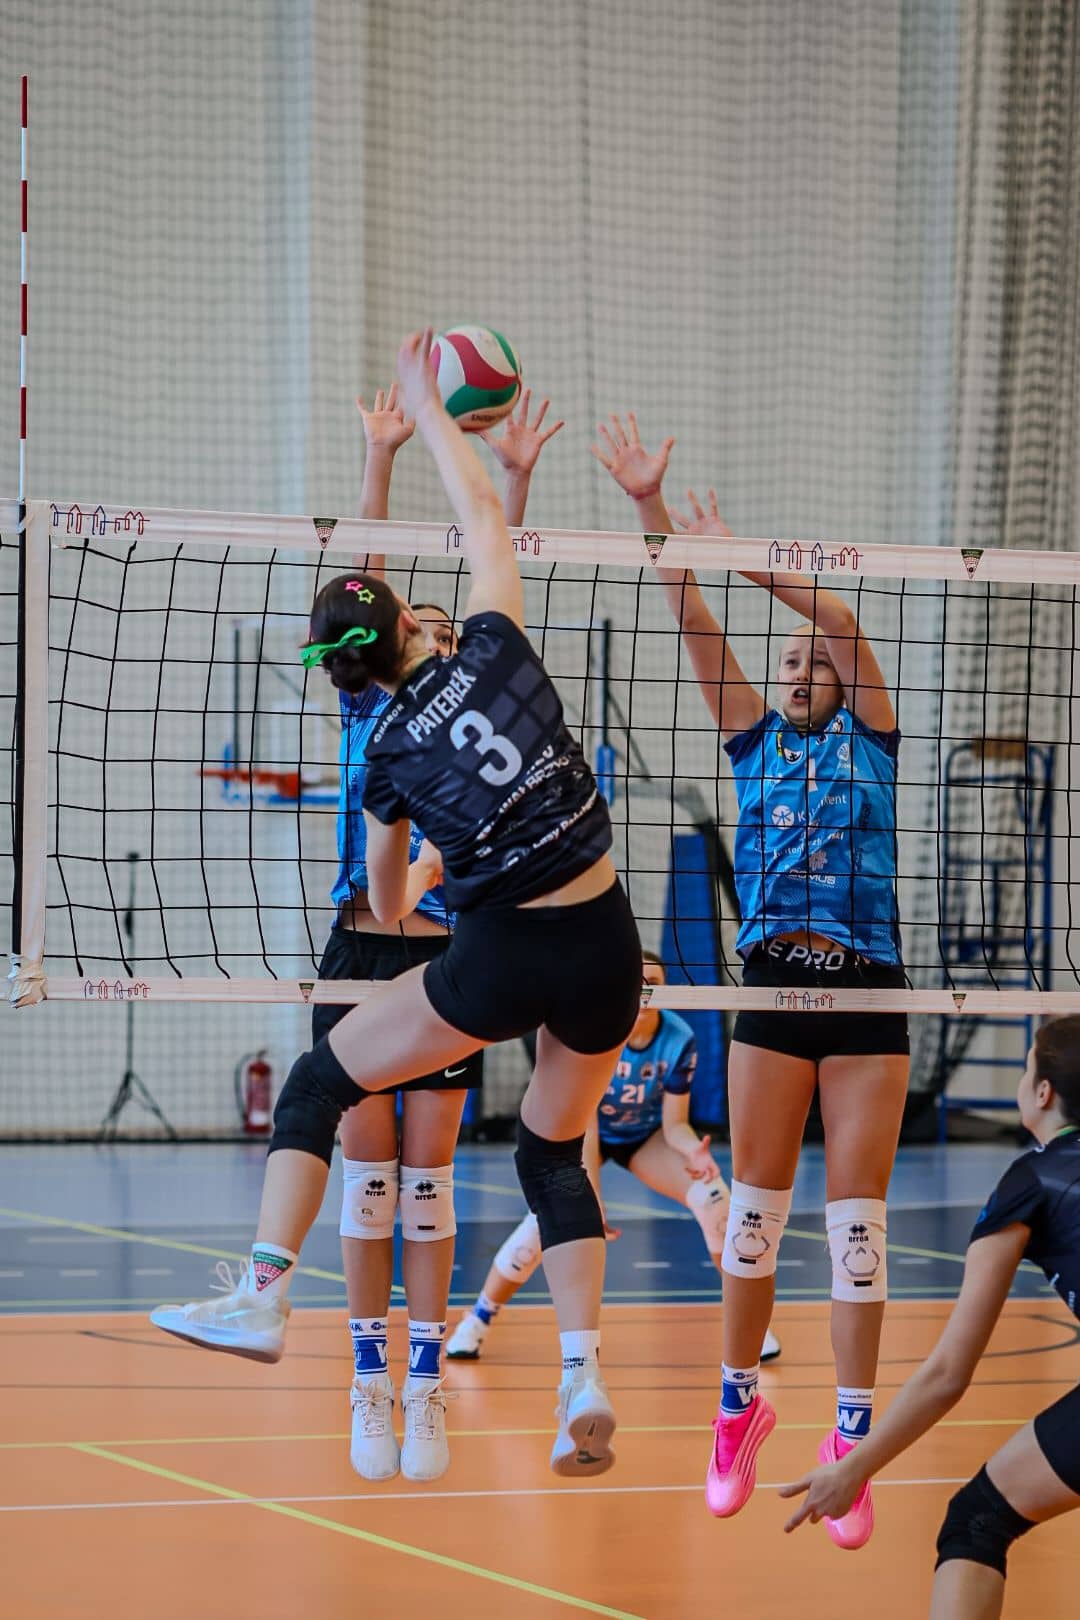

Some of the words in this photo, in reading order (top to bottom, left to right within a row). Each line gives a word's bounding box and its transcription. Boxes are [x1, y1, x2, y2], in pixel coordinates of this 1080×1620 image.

[406, 666, 477, 743] PATEREK
[450, 709, 522, 786] 3
[786, 944, 845, 971] PRO
[620, 1084, 645, 1105] 21
